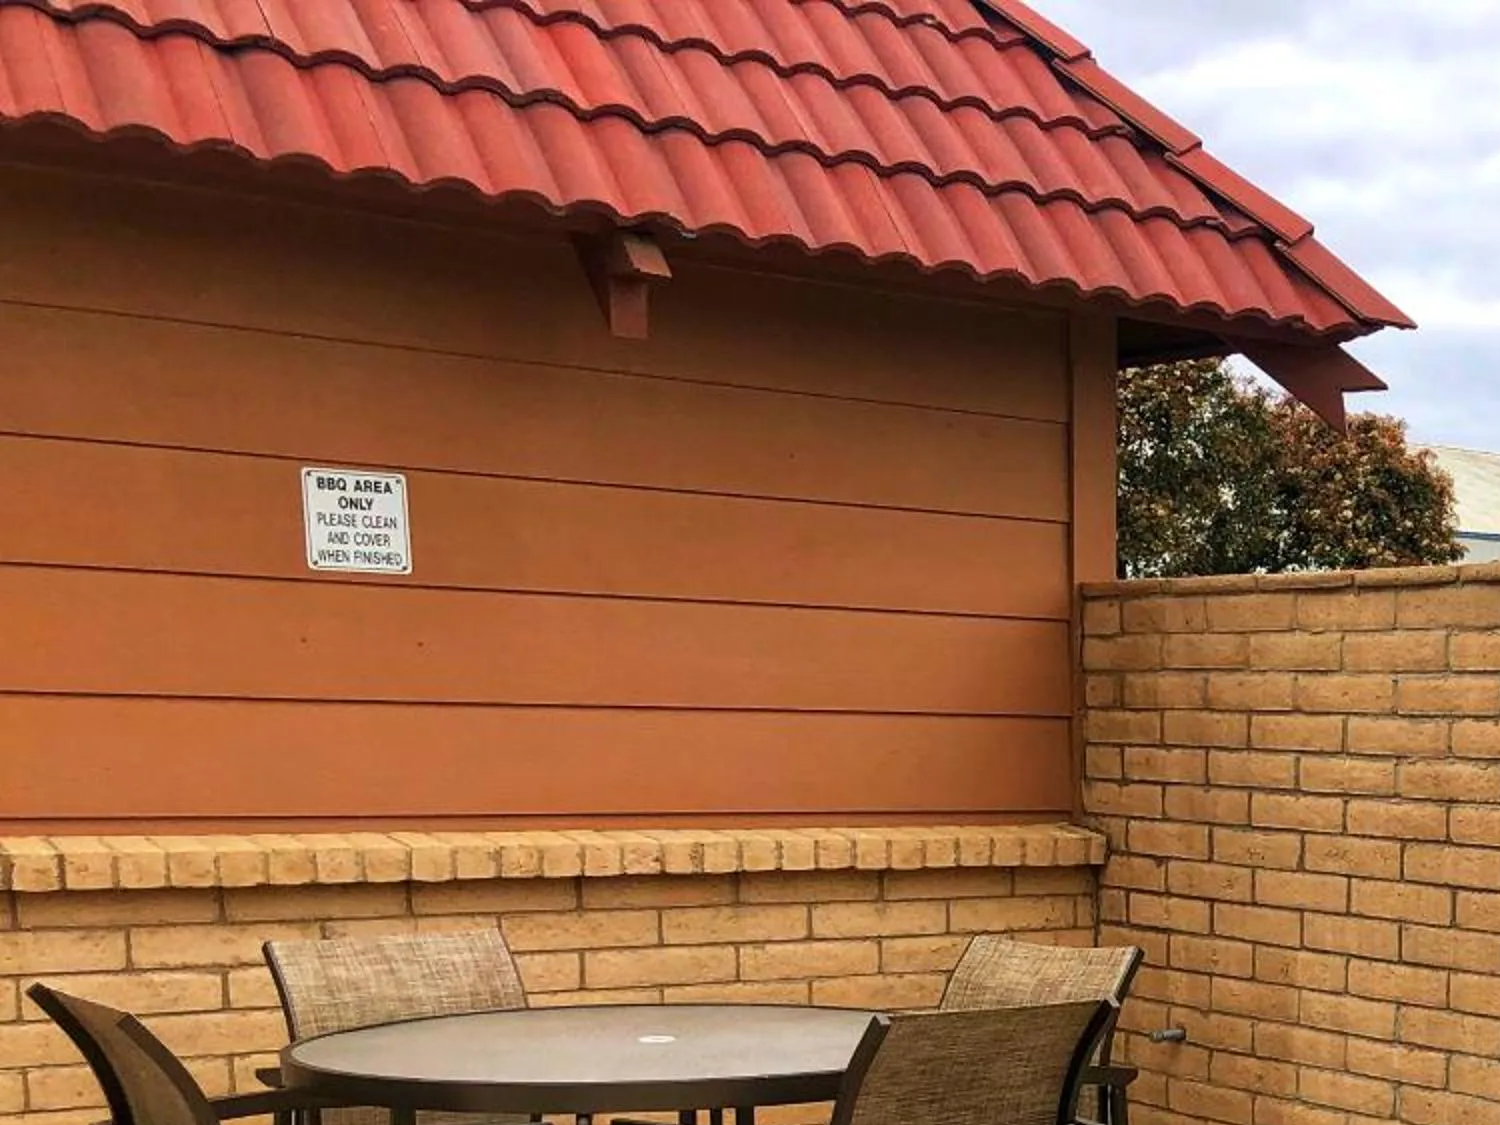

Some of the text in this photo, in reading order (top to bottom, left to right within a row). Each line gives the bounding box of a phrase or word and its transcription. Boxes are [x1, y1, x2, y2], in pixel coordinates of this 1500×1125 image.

[316, 477, 393, 494] BBQ AREA
[338, 496, 374, 510] ONLY
[316, 512, 397, 529] PLEASE CLEAN
[327, 531, 391, 547] AND COVER
[318, 549, 402, 566] WHEN FINISHED
